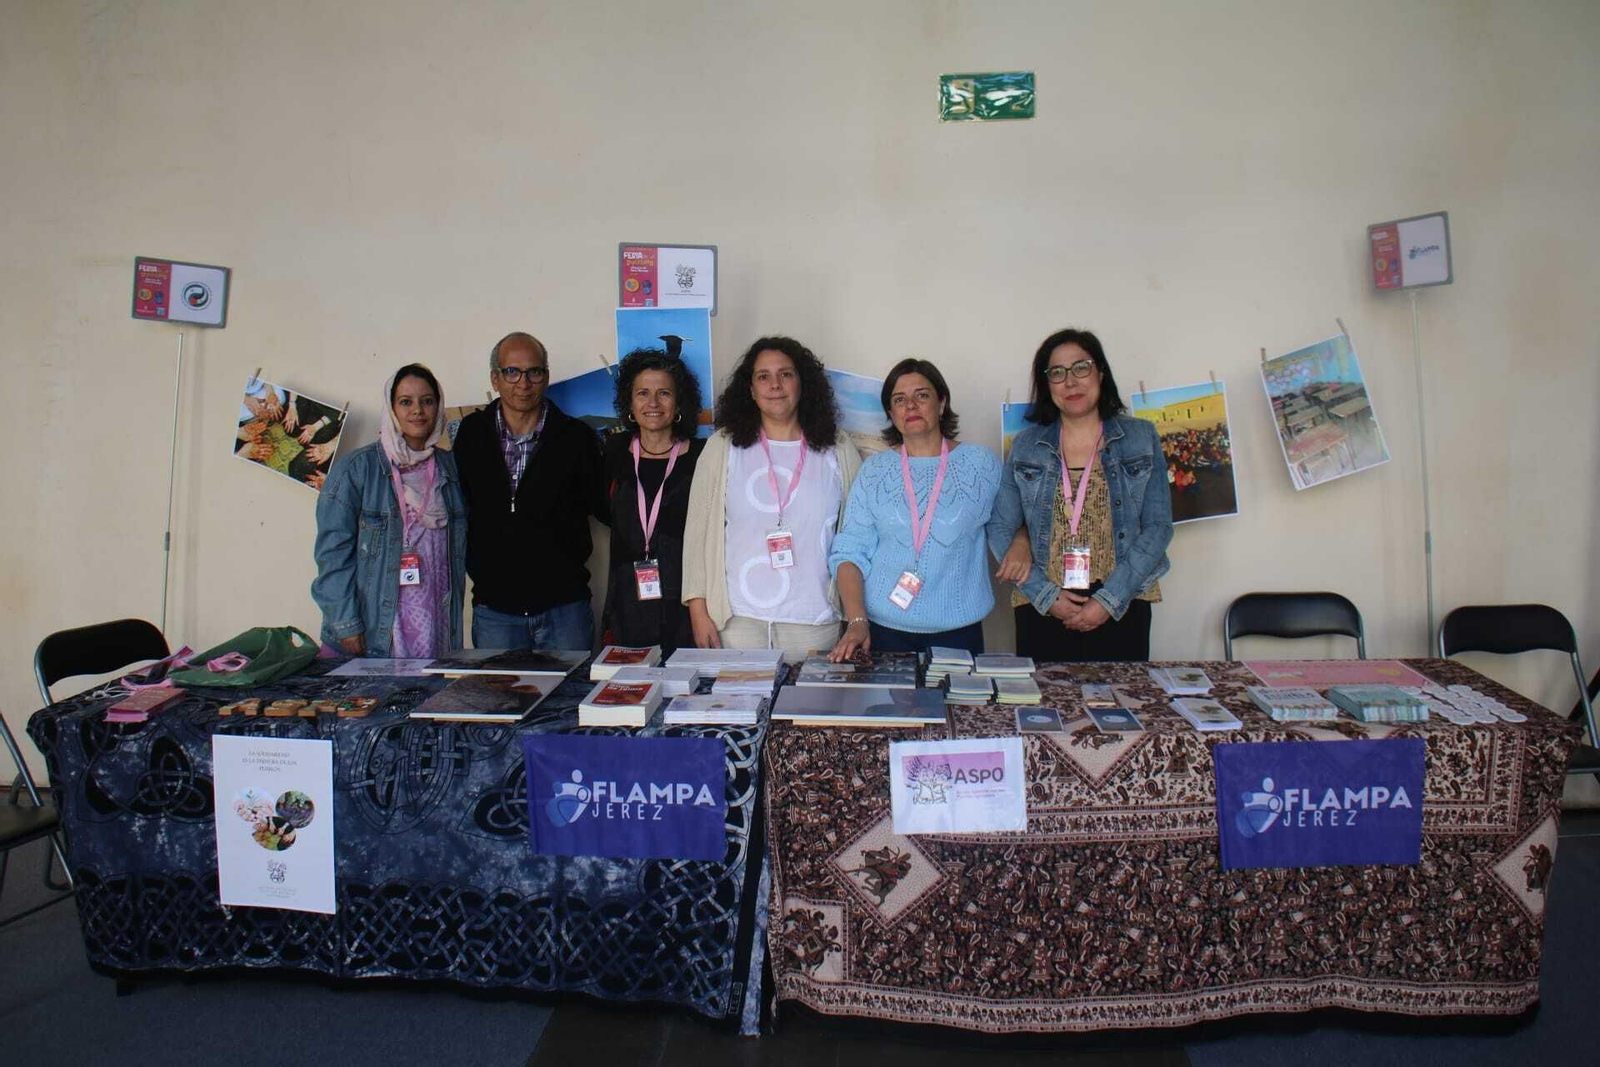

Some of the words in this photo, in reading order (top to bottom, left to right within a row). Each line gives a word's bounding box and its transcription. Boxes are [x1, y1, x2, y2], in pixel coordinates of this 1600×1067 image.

[954, 767, 1004, 784] ASPO
[592, 781, 716, 806] FLAMPA
[1284, 786, 1412, 811] FLAMPA
[592, 803, 663, 820] JEREZ
[1283, 810, 1357, 827] JEREZ
